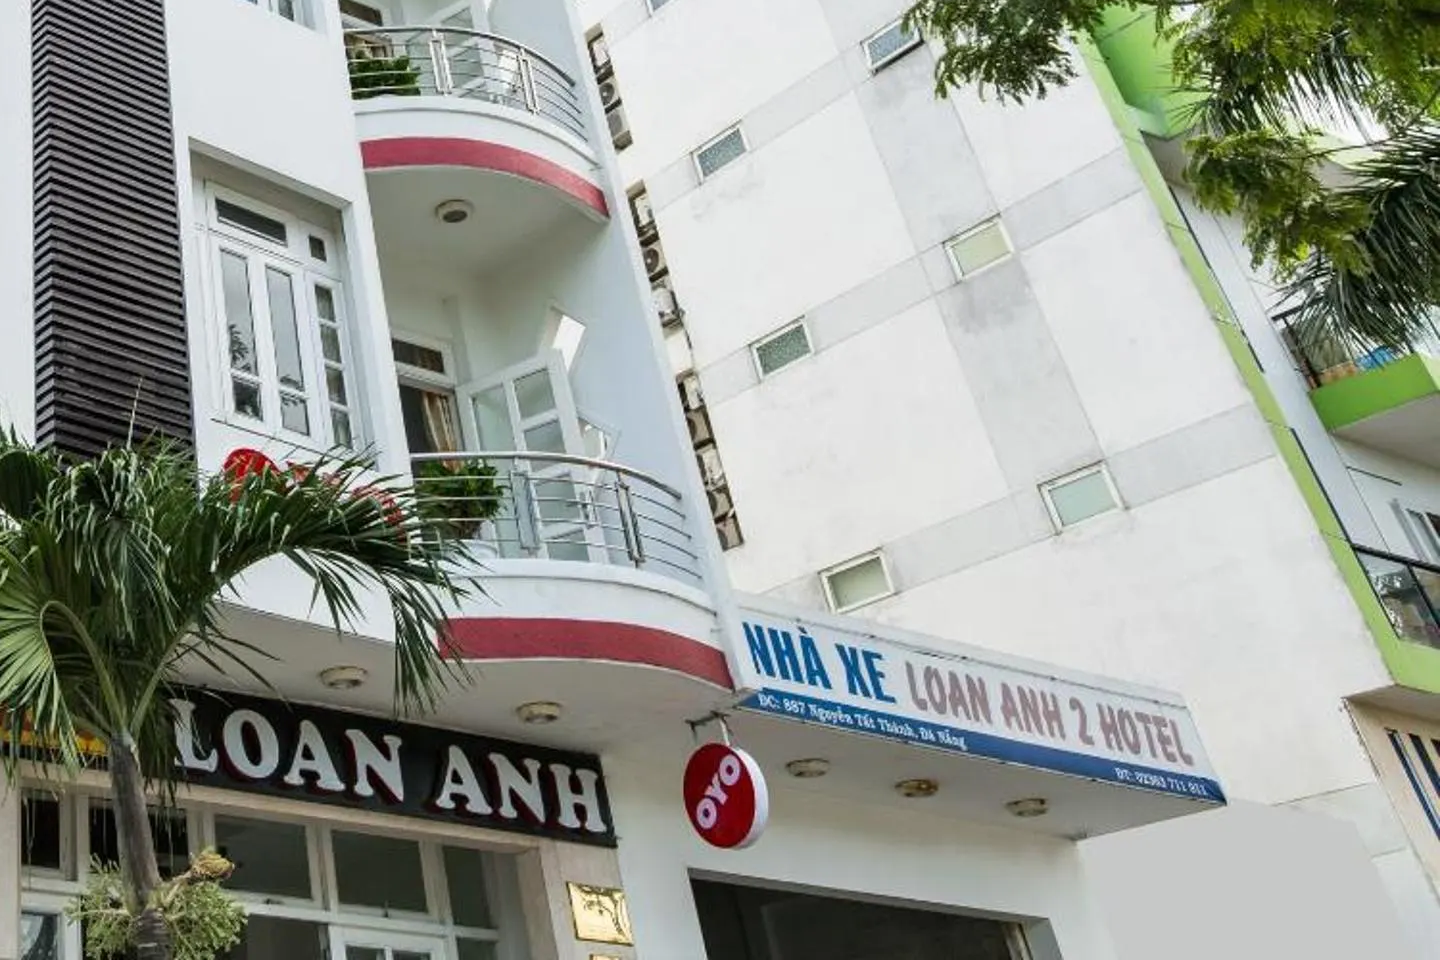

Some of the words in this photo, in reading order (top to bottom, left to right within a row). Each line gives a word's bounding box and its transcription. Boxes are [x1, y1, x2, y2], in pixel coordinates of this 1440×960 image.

[741, 621, 833, 690] NHÀ
[834, 642, 897, 704] XE
[905, 660, 992, 726] LOAN
[999, 681, 1067, 741] ANH
[1069, 696, 1095, 746] 2
[1096, 702, 1195, 767] HOTEL
[783, 698, 805, 715] 887
[168, 697, 407, 804] LOAN
[436, 744, 609, 833] ANH
[696, 753, 741, 830] OYO
